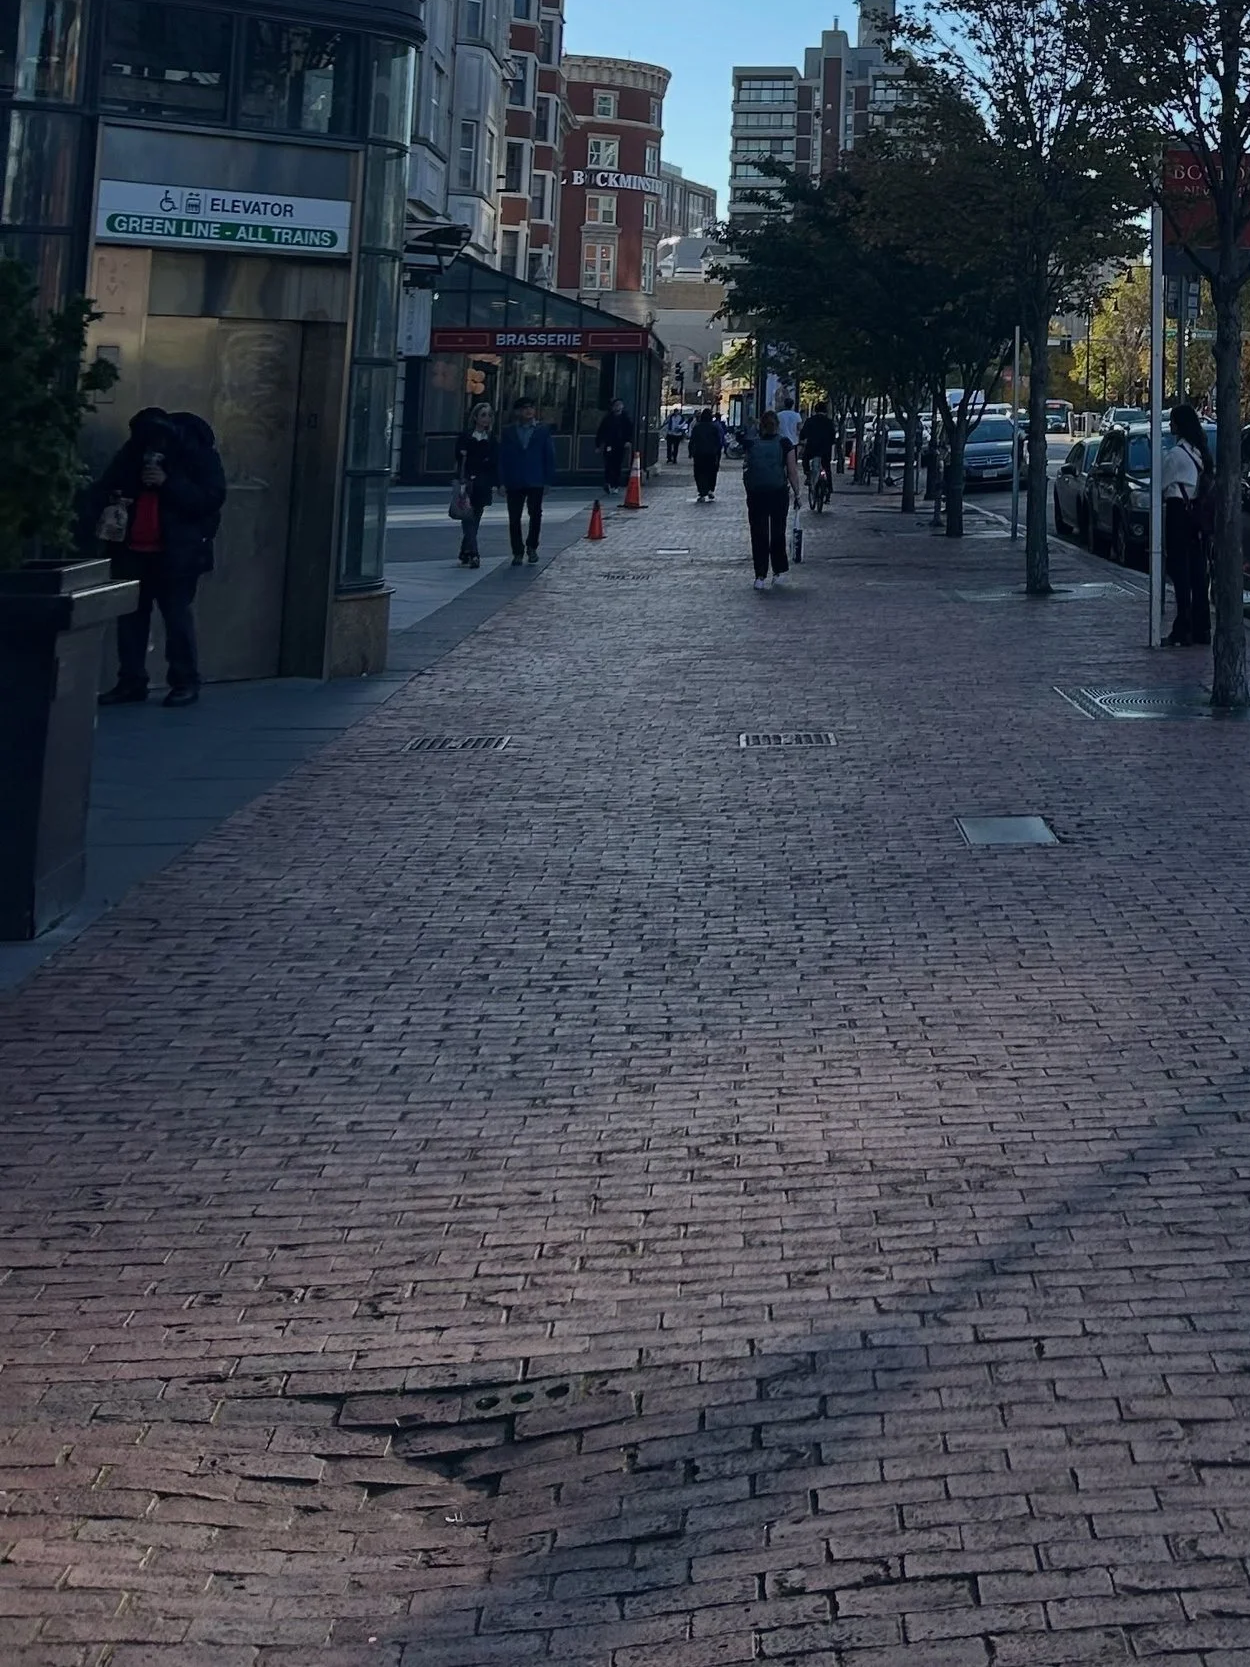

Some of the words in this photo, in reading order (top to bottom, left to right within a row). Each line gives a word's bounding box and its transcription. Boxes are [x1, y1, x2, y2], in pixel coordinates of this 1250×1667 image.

[210, 198, 294, 218] ELEVATOR
[114, 216, 177, 235] GREEN
[182, 221, 221, 239] LINE
[235, 226, 268, 243] ALL
[271, 228, 333, 247] TRAINS
[495, 333, 582, 347] BRASSERIE
